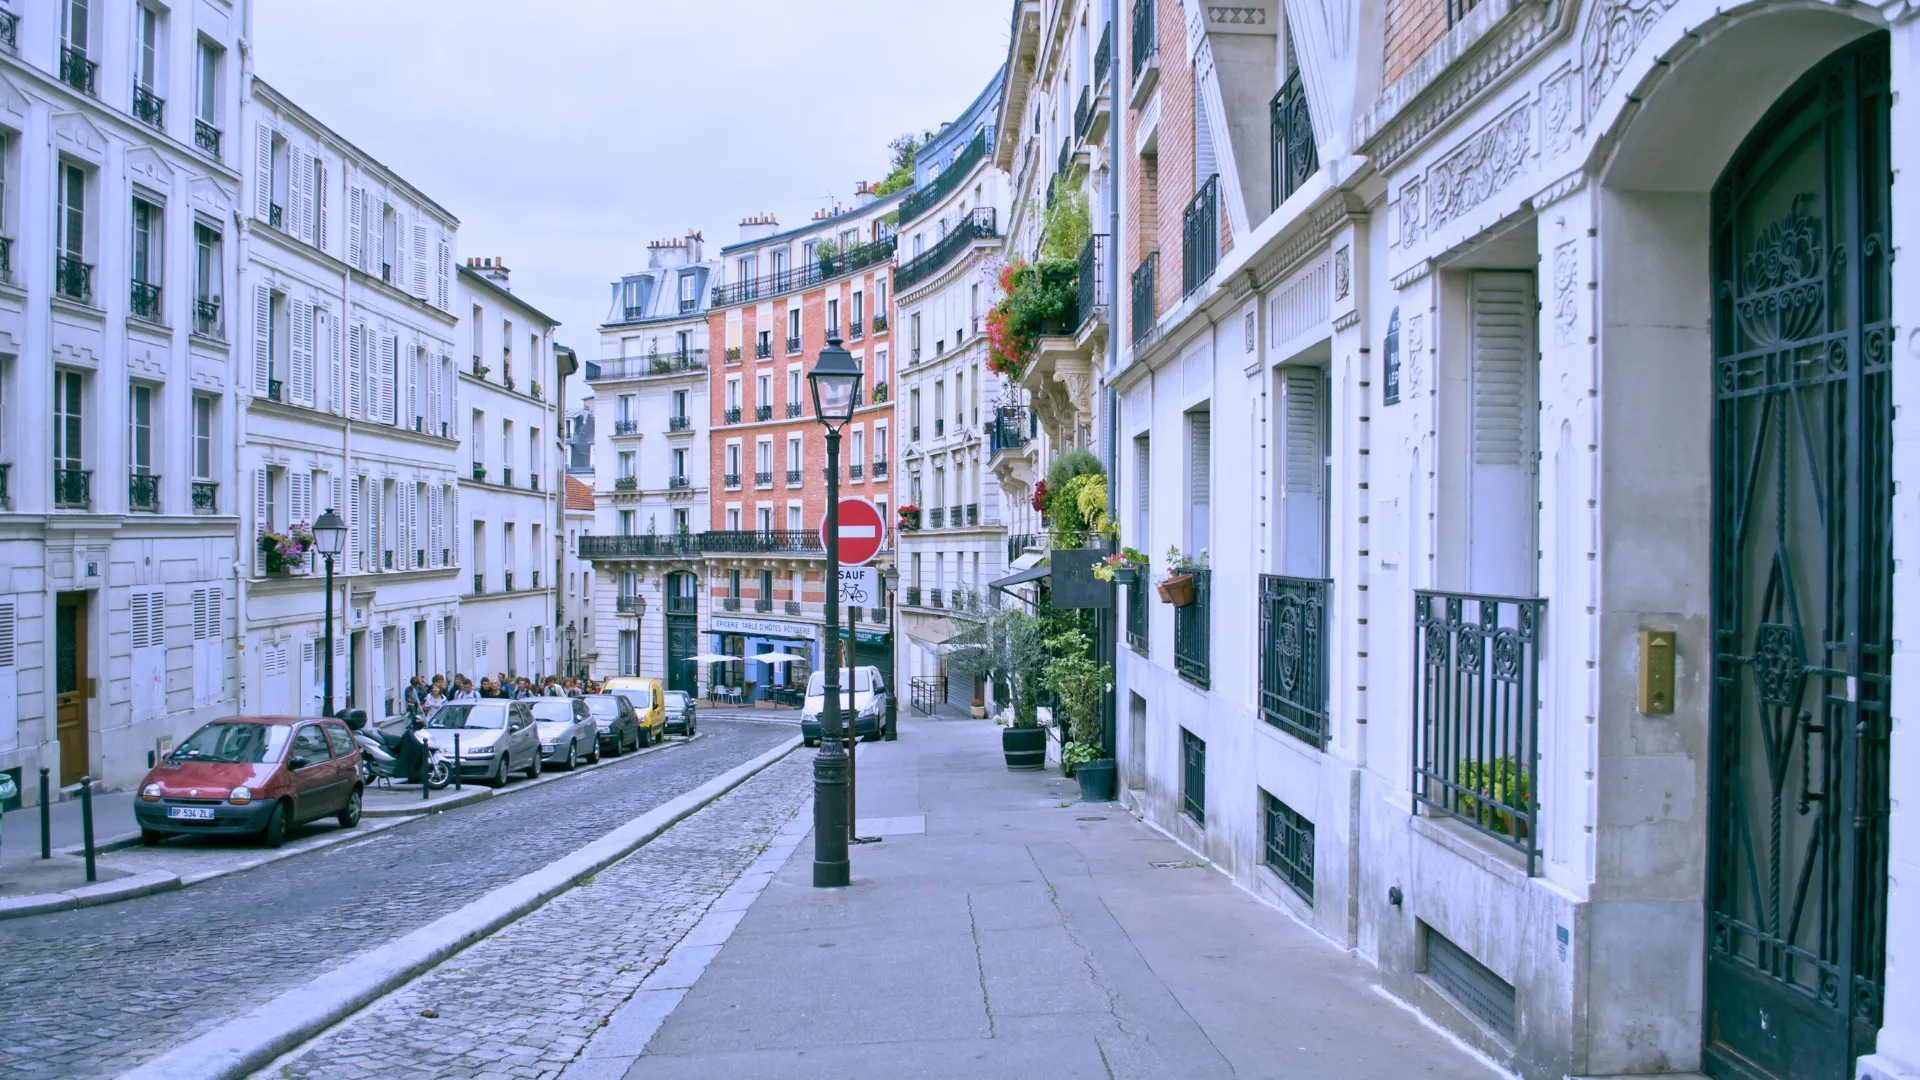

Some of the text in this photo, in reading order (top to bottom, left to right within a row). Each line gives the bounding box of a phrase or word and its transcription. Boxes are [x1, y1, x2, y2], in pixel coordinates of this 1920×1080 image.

[1390, 351, 1398, 366] RU
[1388, 371, 1398, 386] LEP
[838, 570, 865, 580] SAUF
[742, 622, 758, 630] TABLE
